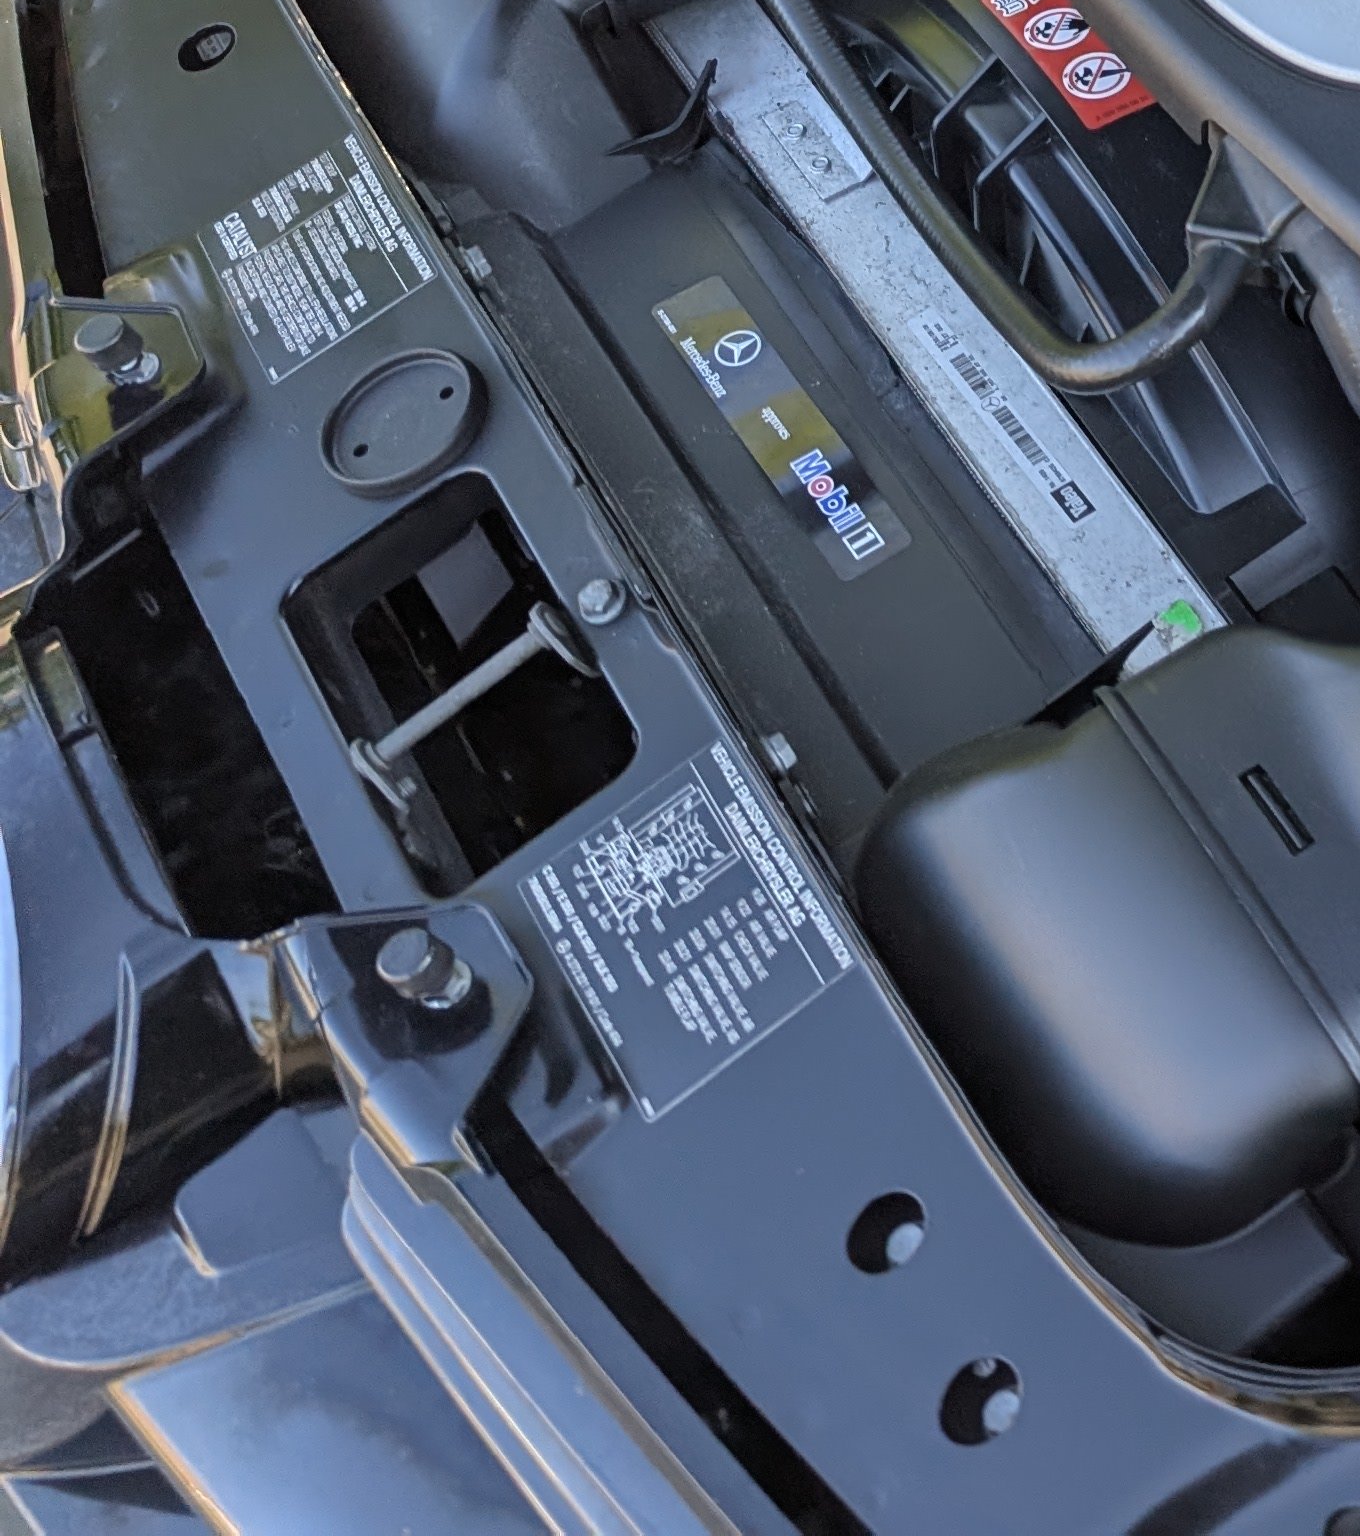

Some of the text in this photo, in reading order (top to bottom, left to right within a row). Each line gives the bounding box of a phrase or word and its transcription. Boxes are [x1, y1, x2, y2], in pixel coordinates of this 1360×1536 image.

[220, 210, 257, 260] CATALYST
[342, 133, 432, 281] VEHICLE EMISSION CONTROL INFORMATION
[348, 173, 398, 253] DAIMLERCHRYSLER AG
[679, 335, 727, 399] Mercedes-Benz
[761, 406, 792, 440] approves
[789, 448, 866, 534] Mobil
[1057, 482, 1087, 519] Valeo
[709, 741, 851, 970] VEHICLE EMISSION CONTROL INFORMATION
[726, 801, 806, 928] DAIMLERCHRYSLER AG
